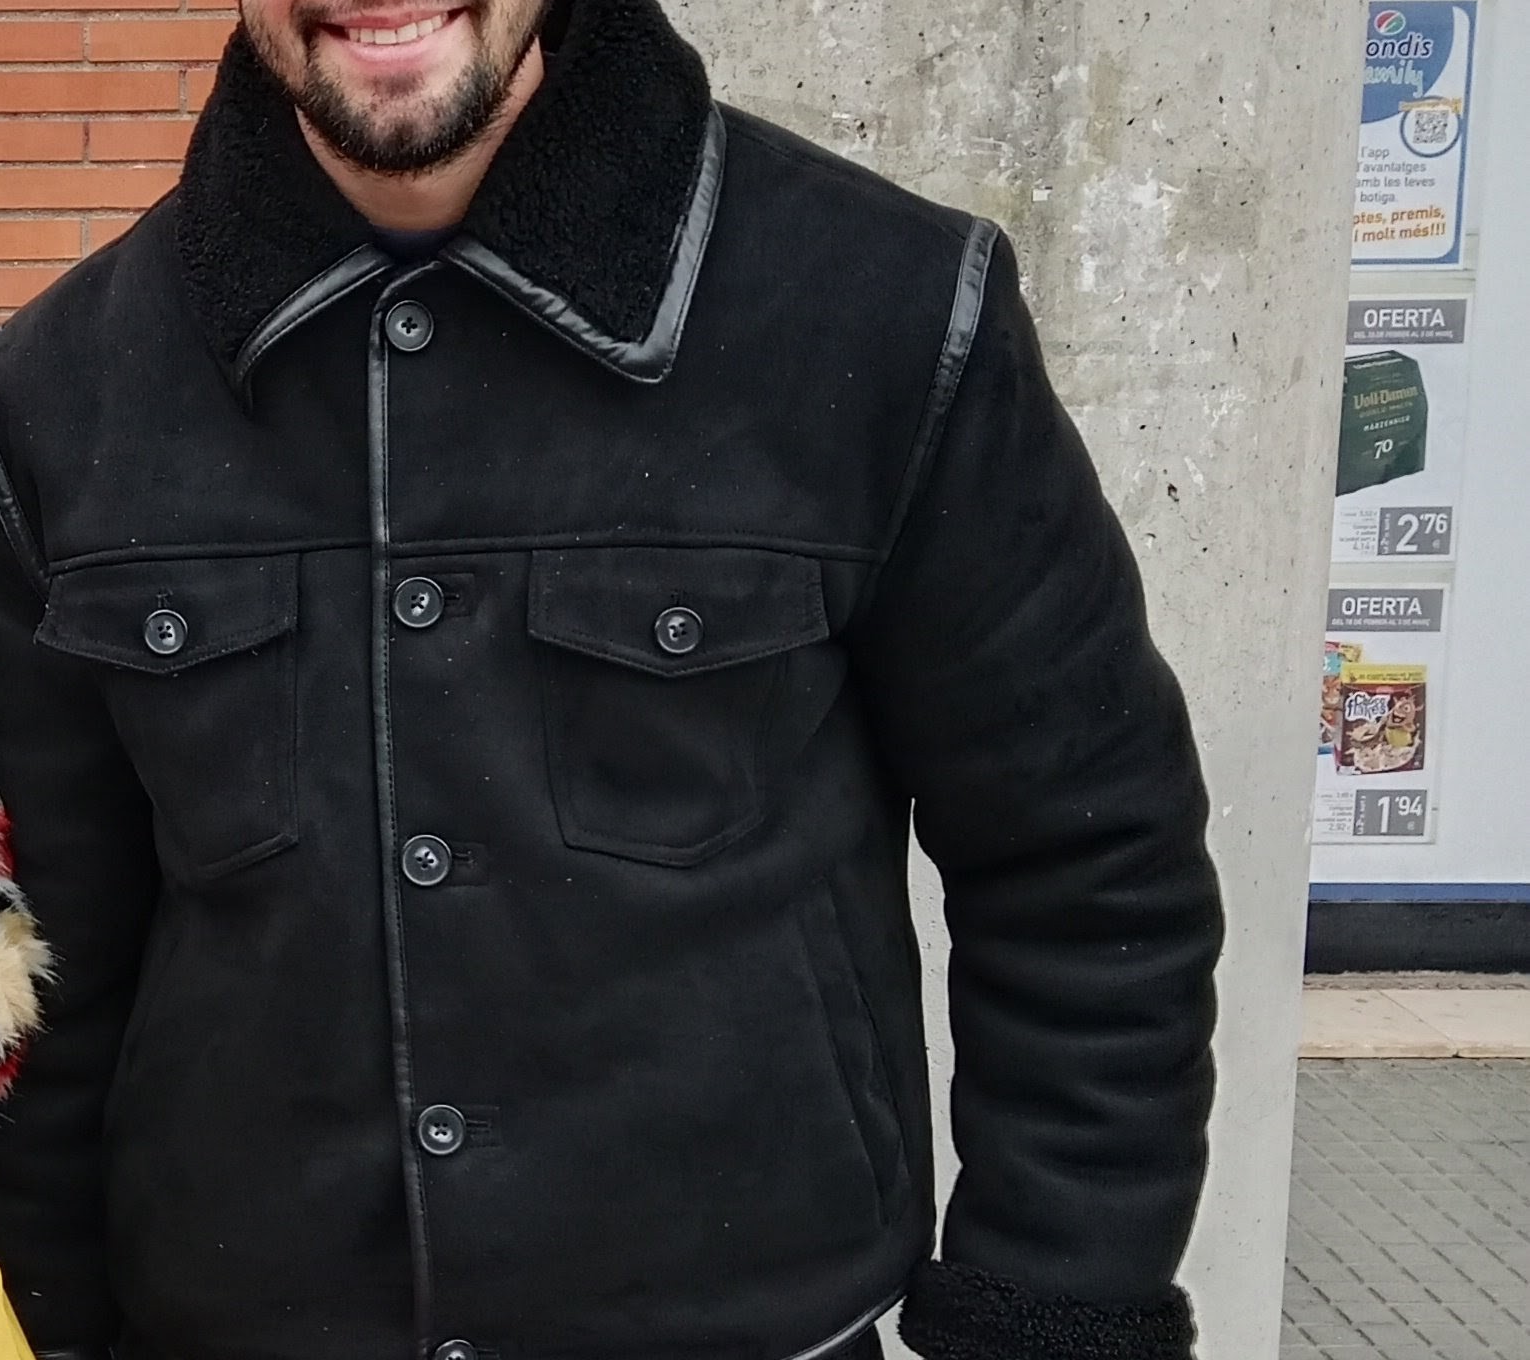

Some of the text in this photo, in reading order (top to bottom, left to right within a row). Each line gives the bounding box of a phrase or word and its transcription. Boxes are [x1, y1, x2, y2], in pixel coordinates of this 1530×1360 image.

[1365, 32, 1433, 58] ondis
[1364, 59, 1424, 99] amily
[1364, 308, 1445, 328] OFERTA
[1342, 596, 1422, 616] OFERTA
